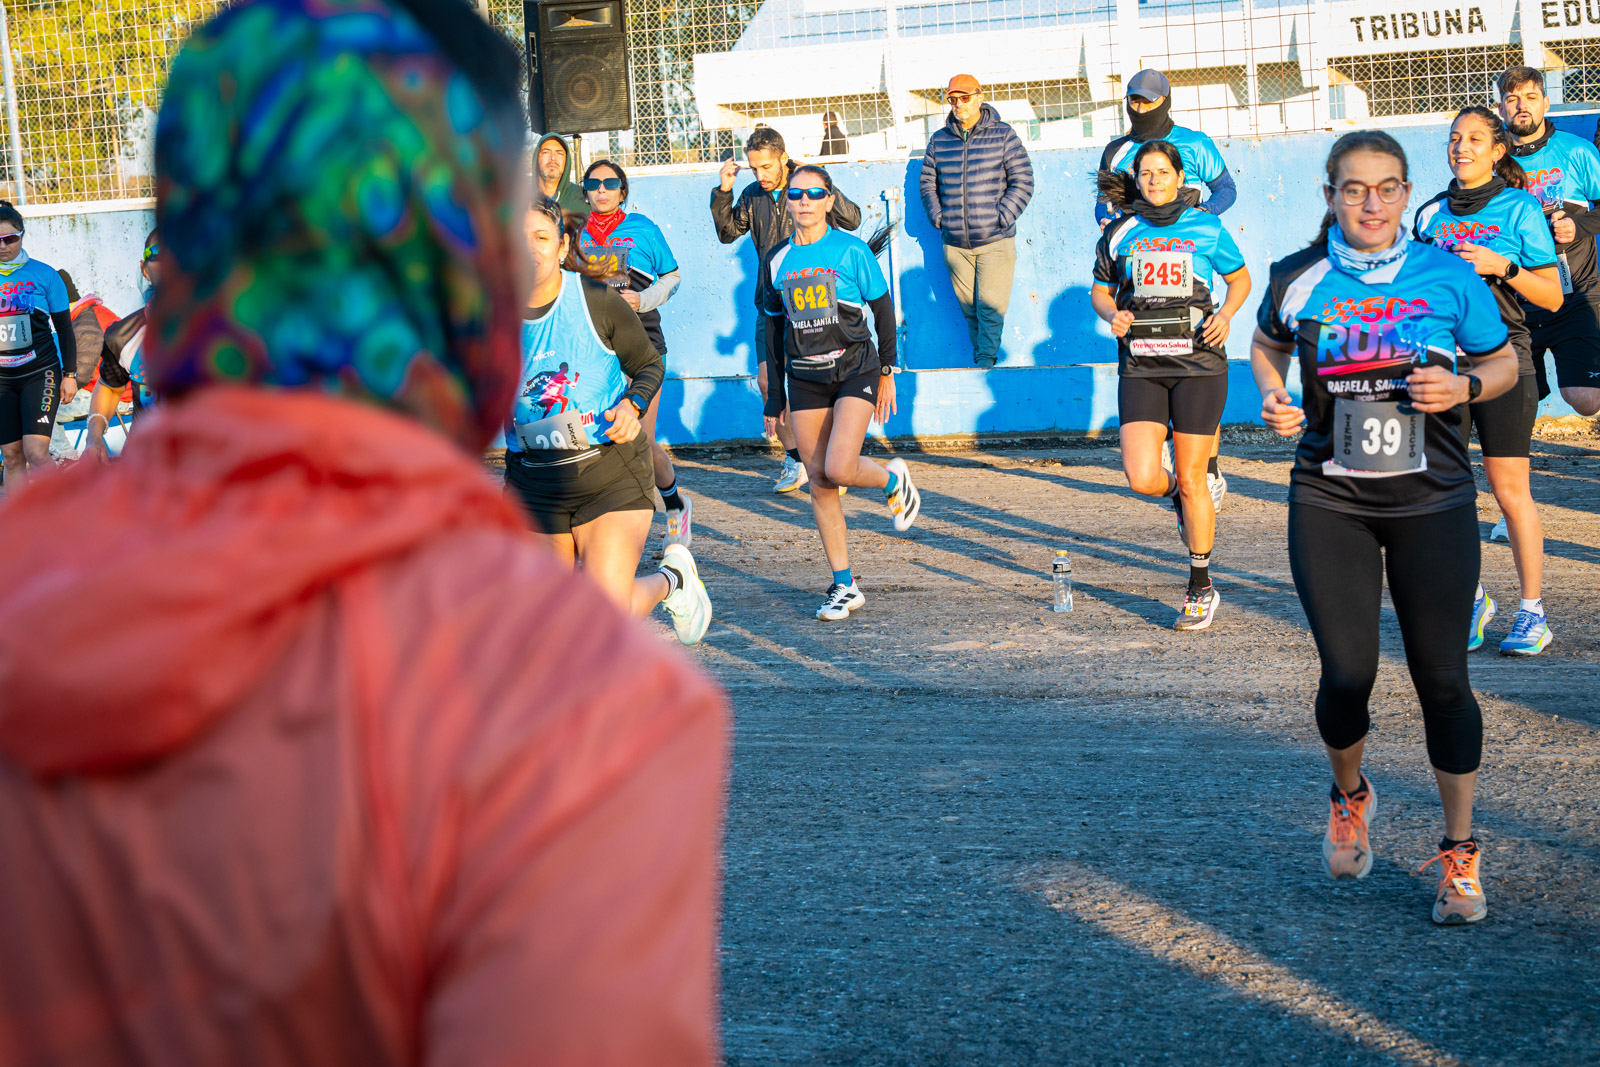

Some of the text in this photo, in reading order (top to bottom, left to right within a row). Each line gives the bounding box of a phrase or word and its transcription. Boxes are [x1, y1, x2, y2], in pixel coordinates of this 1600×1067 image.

[1350, 6, 1488, 42] TRIBUNA
[1143, 262, 1182, 286] 245
[793, 284, 828, 311] 642
[1358, 296, 1429, 323] 500
[833, 315, 840, 324] FE
[1316, 322, 1412, 363] RUN
[41, 370, 56, 412] adidas
[1327, 379, 1373, 394] RAFAELA,
[1344, 413, 1353, 455] TIEMPO
[1362, 417, 1402, 457] 39
